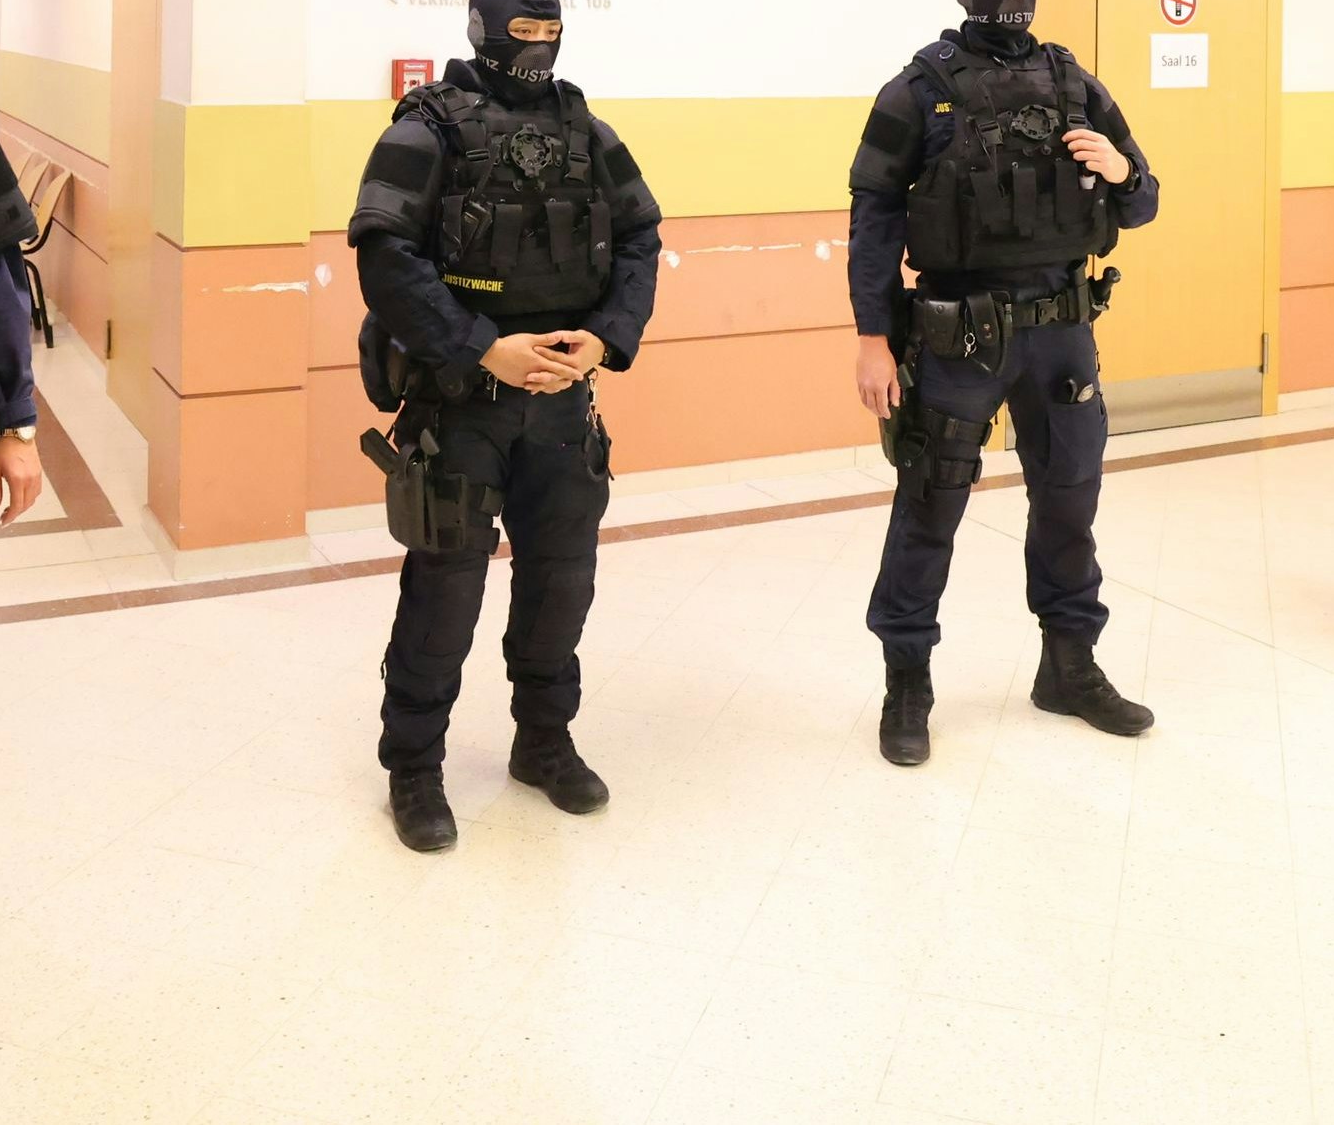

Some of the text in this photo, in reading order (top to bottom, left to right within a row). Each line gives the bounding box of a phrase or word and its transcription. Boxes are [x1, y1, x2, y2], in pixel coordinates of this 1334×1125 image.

[1161, 54, 1197, 67] Saal 16
[442, 274, 504, 292] JUSTIZWACHE
